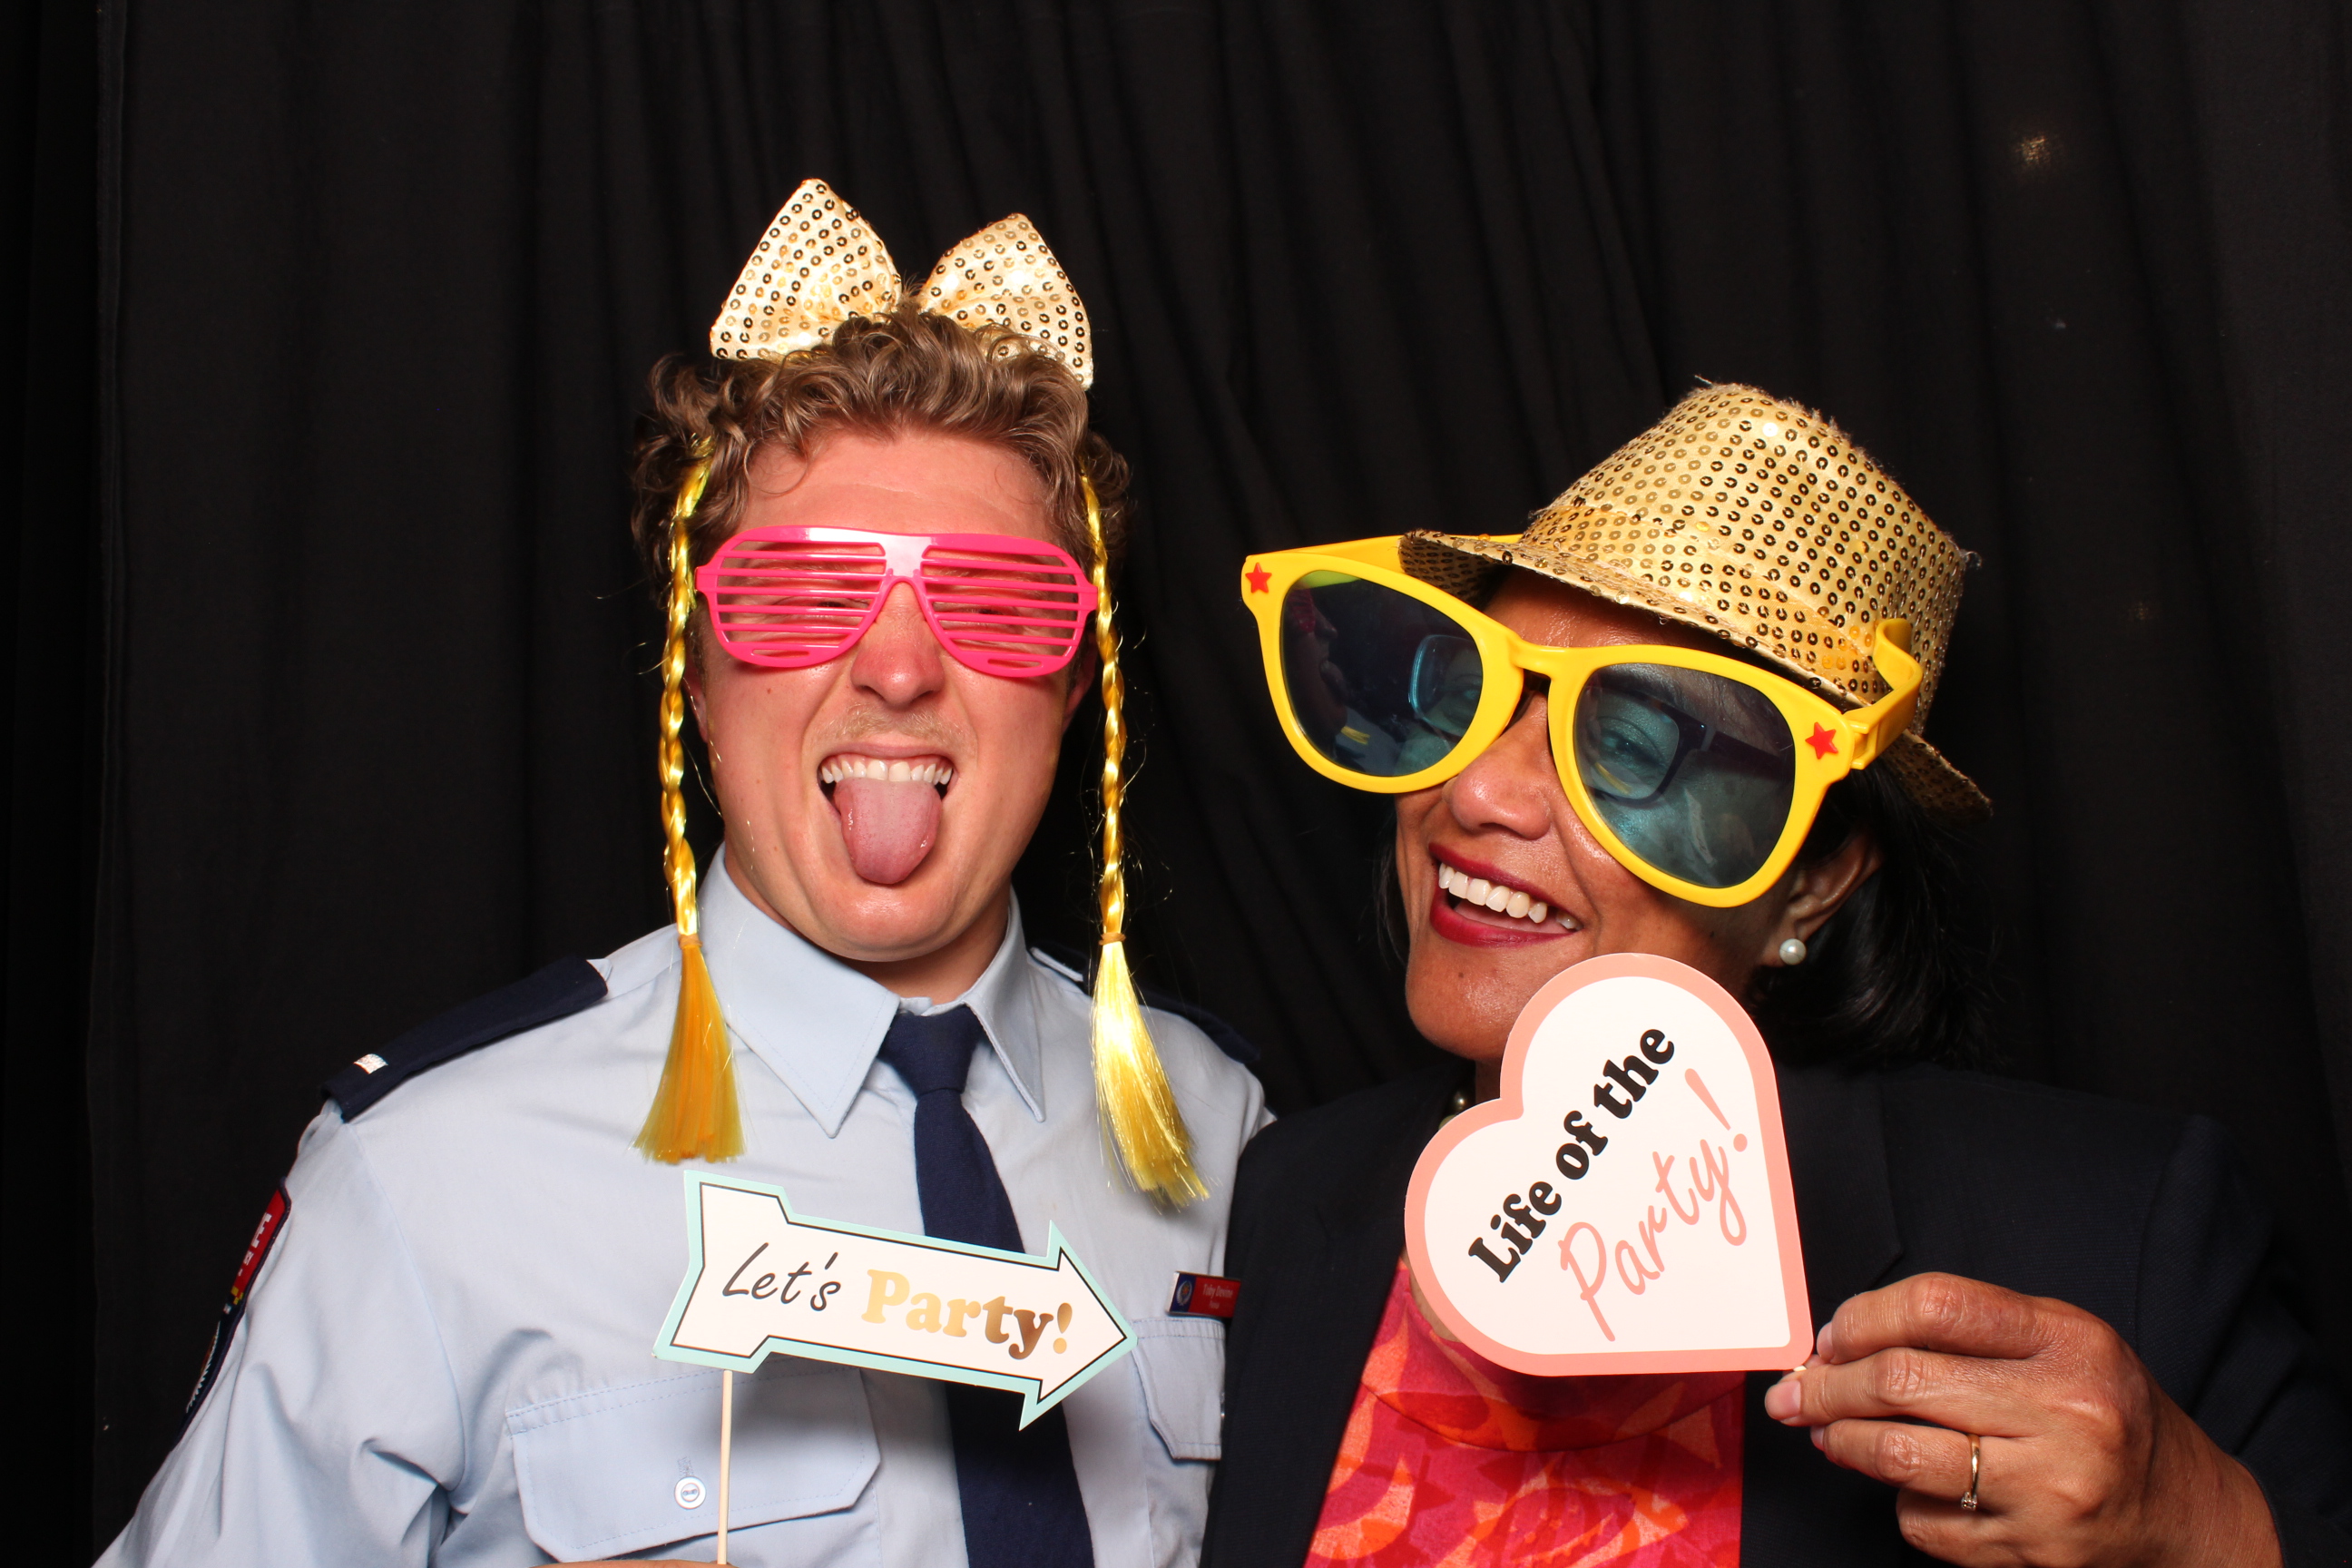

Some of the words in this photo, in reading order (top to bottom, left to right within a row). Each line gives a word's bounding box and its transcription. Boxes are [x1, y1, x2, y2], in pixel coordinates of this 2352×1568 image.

[1467, 1181, 1563, 1284] Life
[1555, 1110, 1609, 1181] of
[1593, 1028, 1675, 1120] the
[1557, 1067, 1749, 1342] Party!
[721, 1241, 841, 1312] Let's
[860, 1268, 1073, 1360] Party!
